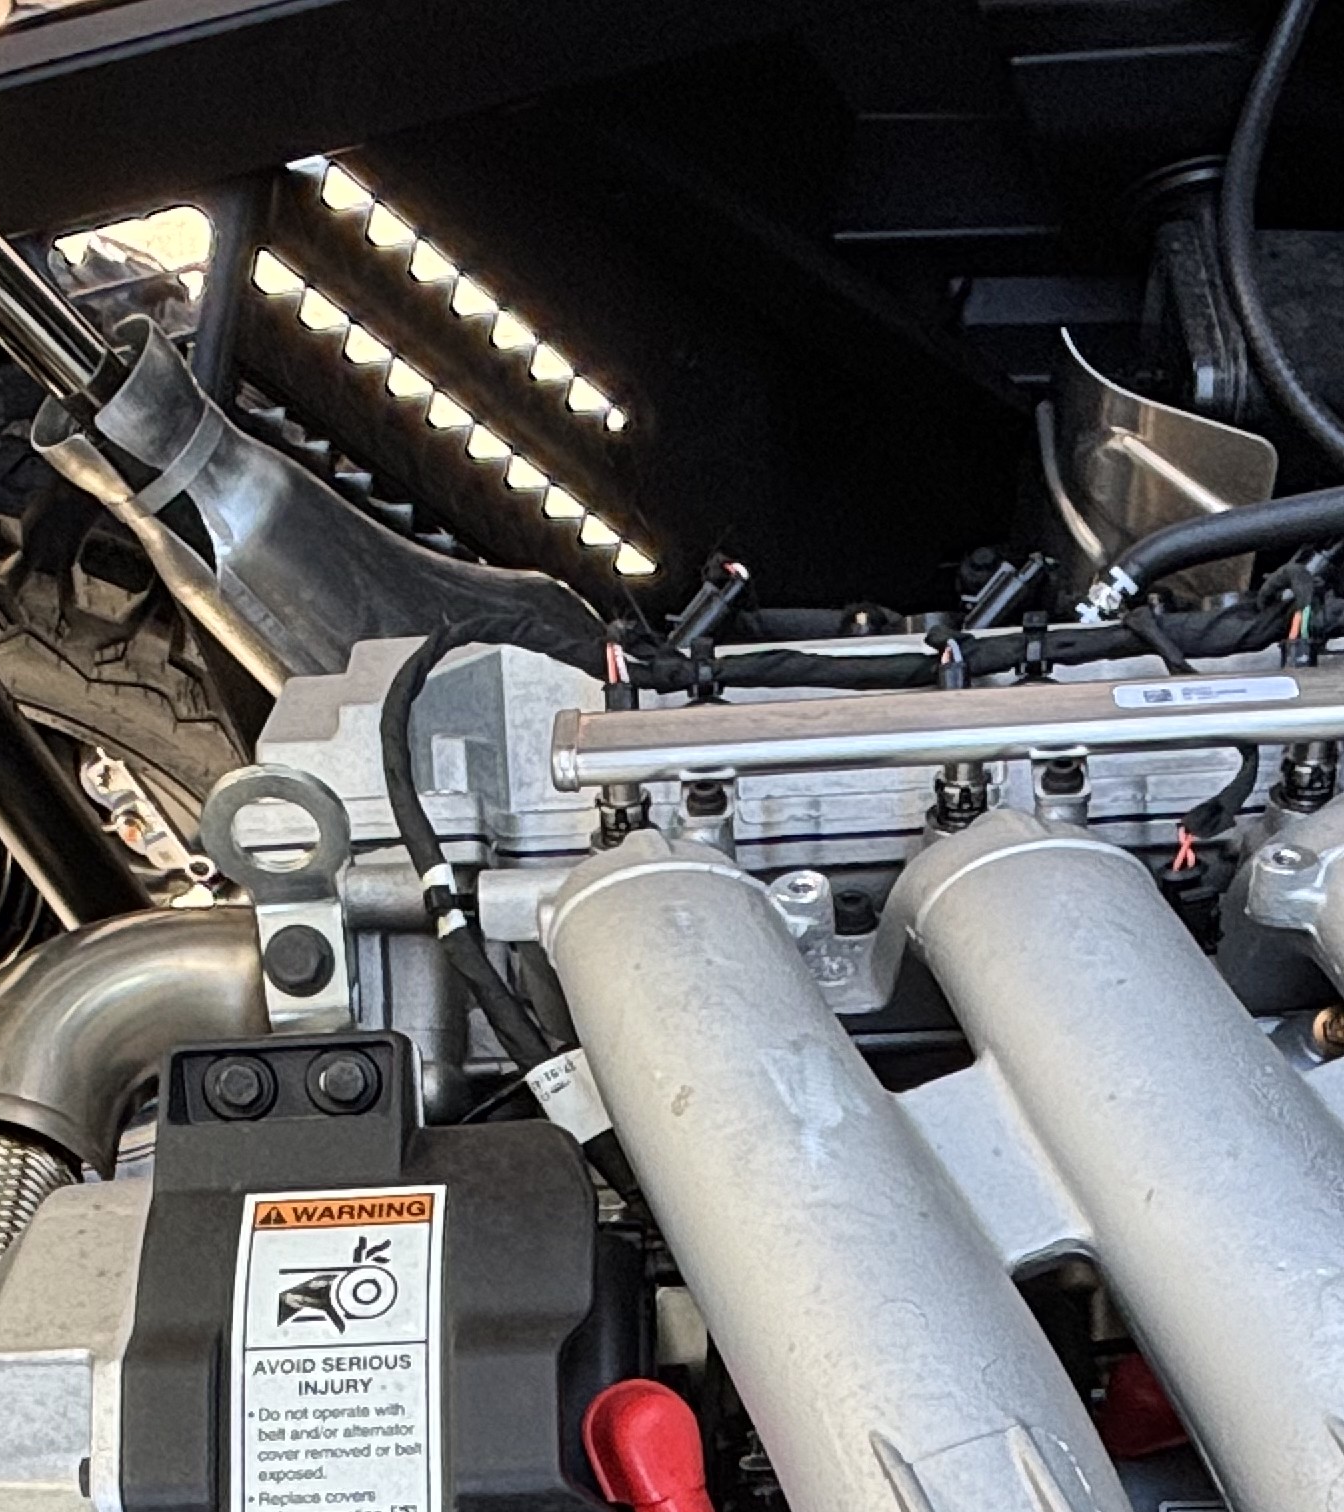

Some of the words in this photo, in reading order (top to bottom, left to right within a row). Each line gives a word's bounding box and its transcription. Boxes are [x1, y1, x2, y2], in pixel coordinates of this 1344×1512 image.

[292, 1200, 427, 1223] WARNING
[253, 1358, 316, 1376] AVOID
[321, 1354, 412, 1372] SERIOUS
[298, 1377, 373, 1396] INJURY
[258, 1407, 281, 1422] Do
[285, 1407, 308, 1421] not
[312, 1405, 370, 1423] operate
[374, 1402, 406, 1417] with
[258, 1427, 286, 1442] belt
[290, 1426, 339, 1441] and/or
[343, 1423, 415, 1439] alternator
[257, 1449, 300, 1462] cover
[305, 1443, 372, 1459] removed
[375, 1445, 391, 1457] or
[394, 1442, 422, 1457] belt
[258, 1465, 327, 1484] exposed.
[258, 1491, 321, 1507] Replace
[325, 1490, 376, 1503] covers
